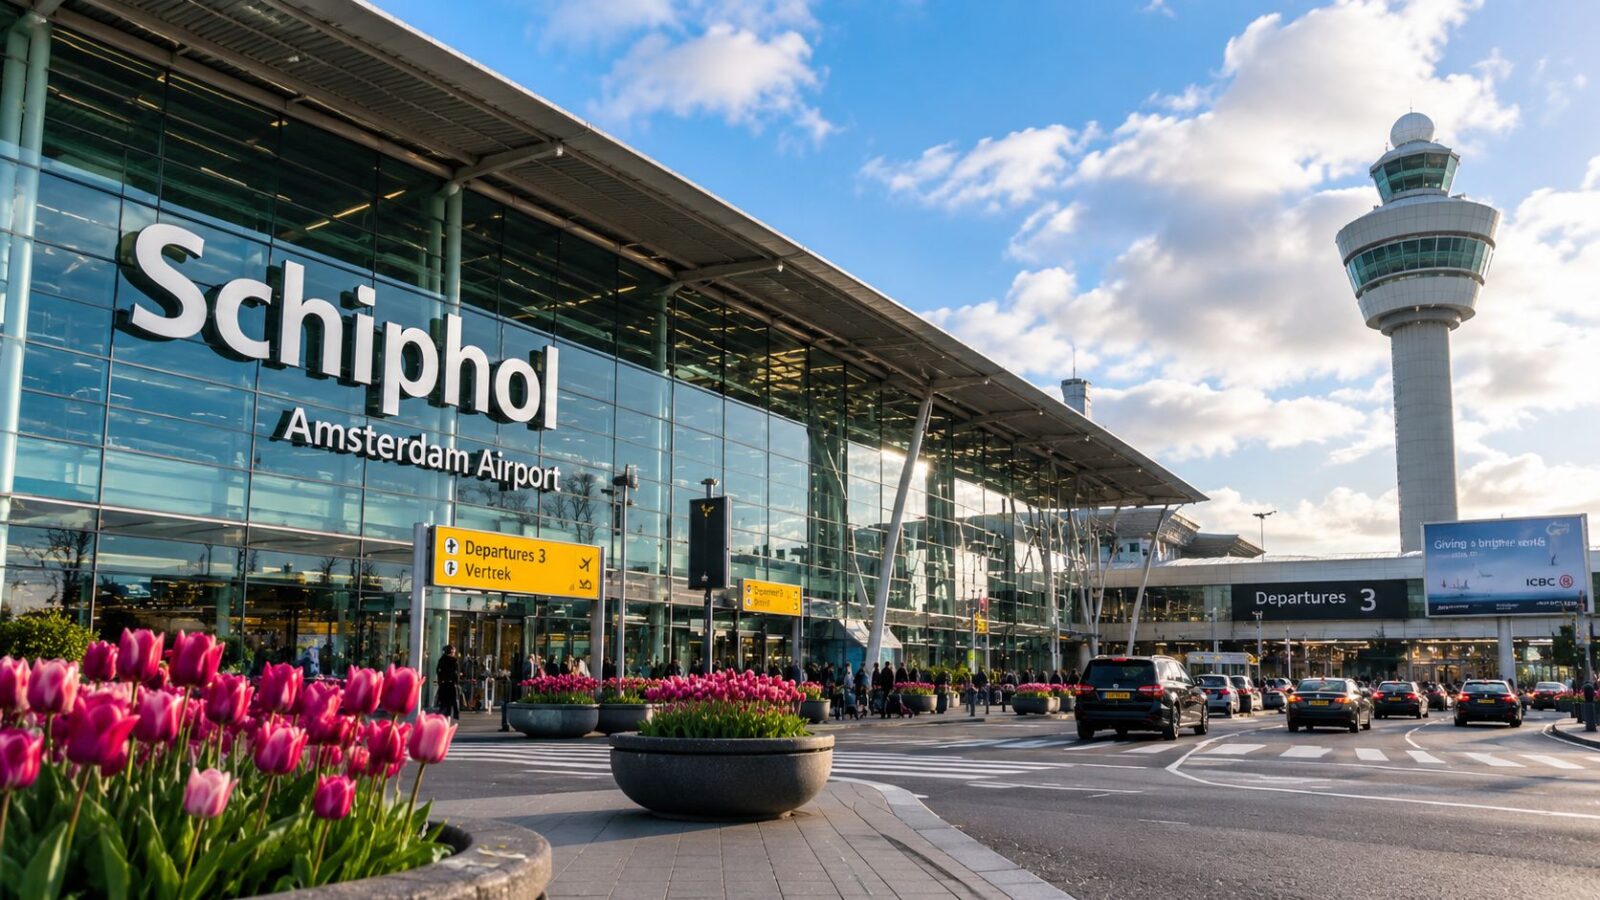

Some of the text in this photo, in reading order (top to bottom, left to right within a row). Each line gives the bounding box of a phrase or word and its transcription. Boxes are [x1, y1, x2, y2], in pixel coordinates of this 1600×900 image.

[131, 223, 559, 430] Schiphol
[283, 407, 561, 492] Amsterdam Airport
[465, 540, 546, 564] Departures 3
[1434, 538, 1467, 549] Giving
[465, 563, 511, 581] Vertrek
[1526, 578, 1556, 587] ICBC
[1256, 588, 1377, 612] Departures 3
